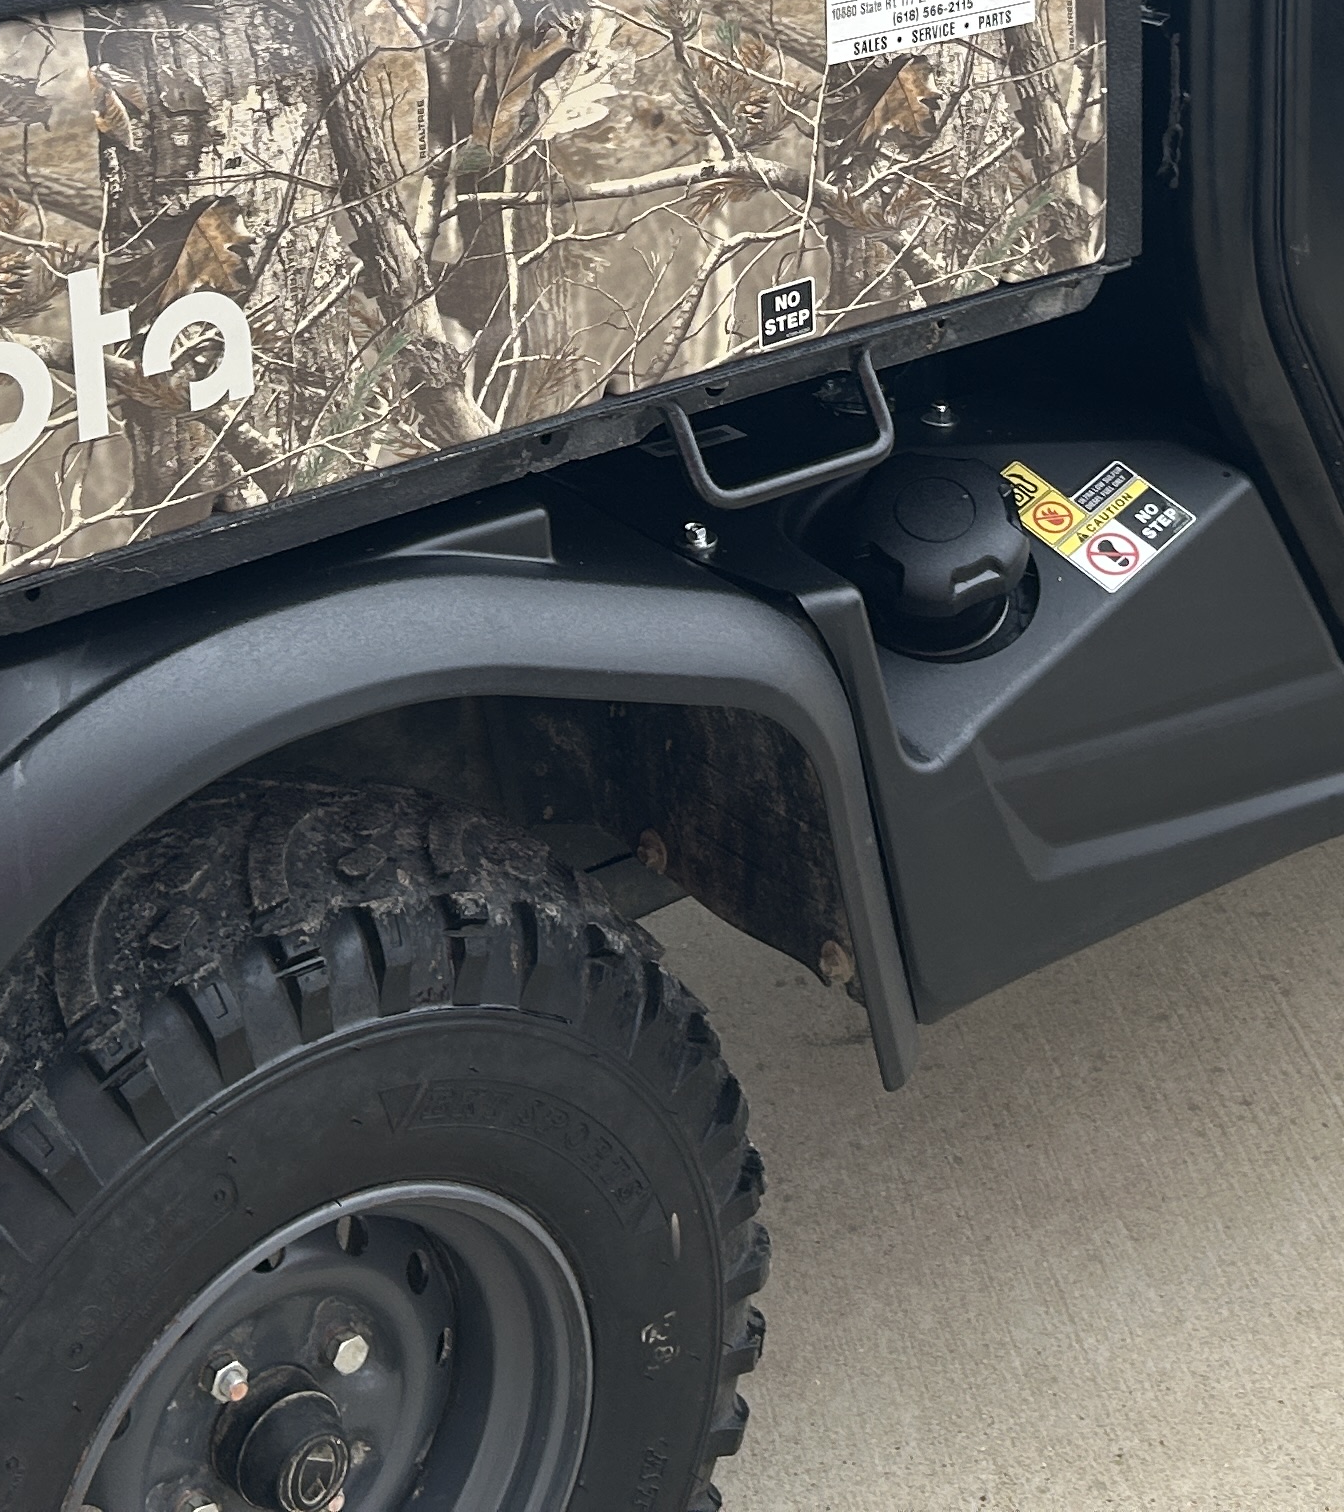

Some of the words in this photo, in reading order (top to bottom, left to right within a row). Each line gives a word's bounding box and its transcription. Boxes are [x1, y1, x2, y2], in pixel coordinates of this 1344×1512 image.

[860, 0, 882, 16] State
[892, 6, 919, 27] (618)
[853, 35, 888, 56] SALES
[911, 21, 956, 44] SERVICE
[978, 9, 1012, 30] PARTS
[774, 290, 801, 312] NO
[764, 308, 810, 336] STEP
[1085, 492, 1134, 533] CAUTION
[1134, 502, 1159, 525] NO
[1141, 506, 1178, 540] STEP
